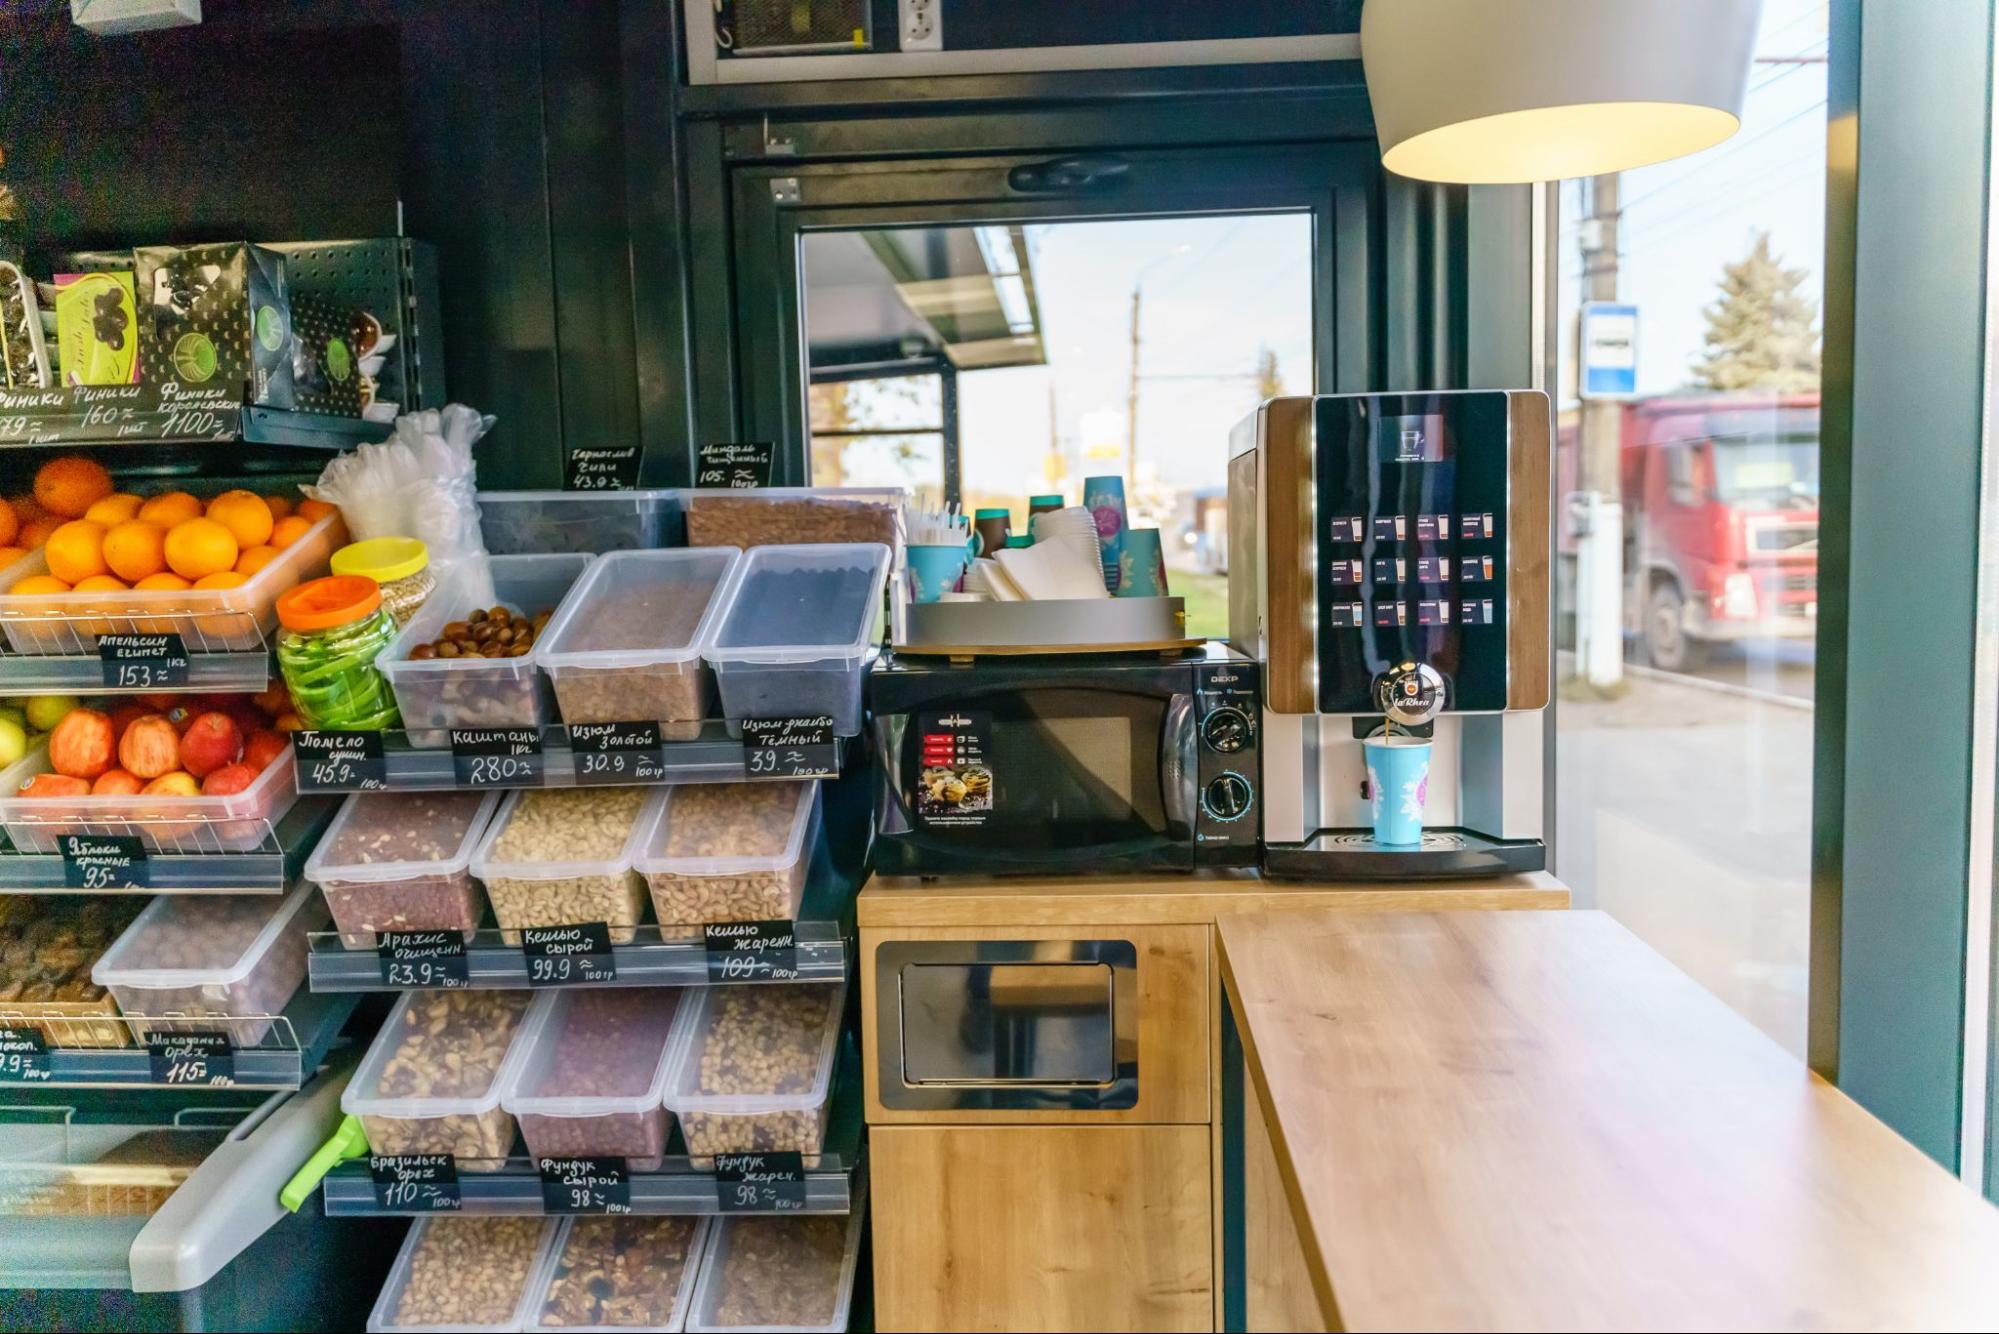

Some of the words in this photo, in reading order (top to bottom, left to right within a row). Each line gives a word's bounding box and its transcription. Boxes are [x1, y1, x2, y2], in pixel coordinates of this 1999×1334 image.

[161, 382, 227, 400] Финики
[119, 664, 151, 687] 153
[298, 730, 364, 749] Помело
[453, 731, 540, 744] Каштаны
[572, 724, 616, 740] Изюм
[471, 756, 517, 785] 280
[582, 754, 625, 773] 30.9
[378, 932, 448, 950] Арахис
[525, 928, 581, 945] Кешью
[705, 925, 759, 938] Кешью
[545, 937, 594, 956] сырой
[532, 957, 571, 981] 99.9
[540, 1158, 597, 1178] Фундук
[563, 1171, 619, 1188] сырой
[384, 1182, 418, 1206] 110
[570, 1188, 591, 1208] 98
